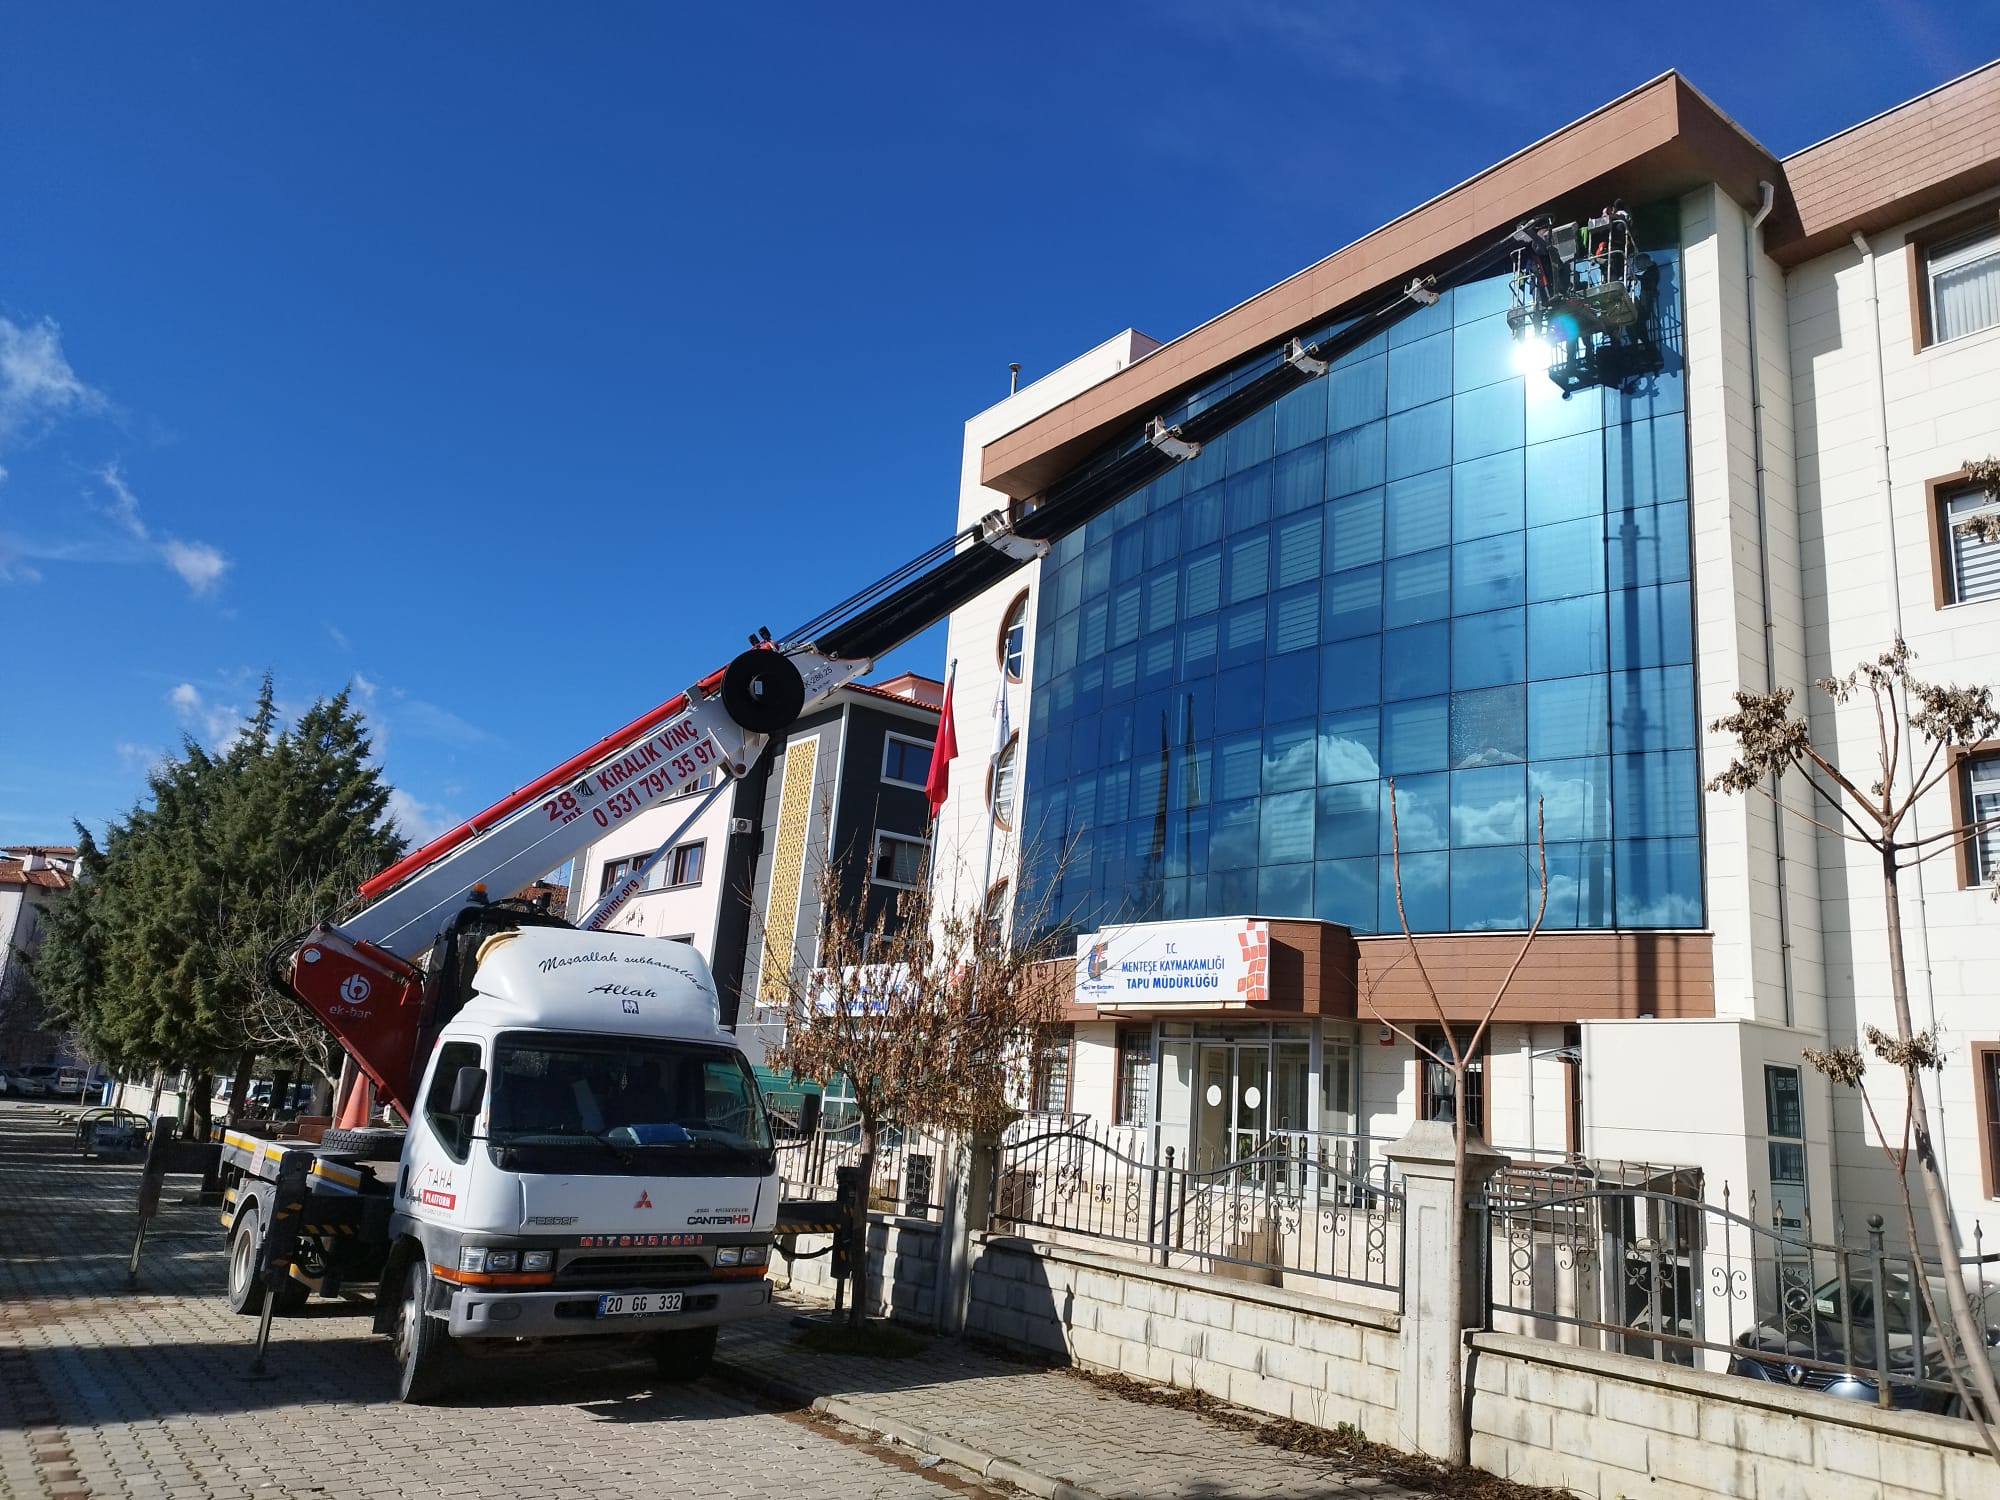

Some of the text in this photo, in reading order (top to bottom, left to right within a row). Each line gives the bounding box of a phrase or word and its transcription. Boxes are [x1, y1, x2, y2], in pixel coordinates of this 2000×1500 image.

[593, 739, 716, 828] 0 531 791 35 97
[543, 791, 577, 821] 28
[562, 806, 584, 824] mt
[1121, 955, 1225, 975] MENTEŞE KAYMAKAMLIĞI
[1127, 977, 1150, 989] TAPU
[1153, 972, 1219, 989] MÜDÜRLÜĞÜ
[587, 983, 657, 998] Allah
[329, 1004, 372, 1018] ek-bar
[428, 1168, 452, 1189] TAHA
[580, 1234, 703, 1247] MITSUBISHI
[607, 1297, 623, 1313] 20
[632, 1296, 648, 1311] GG
[658, 1294, 681, 1310] 332
